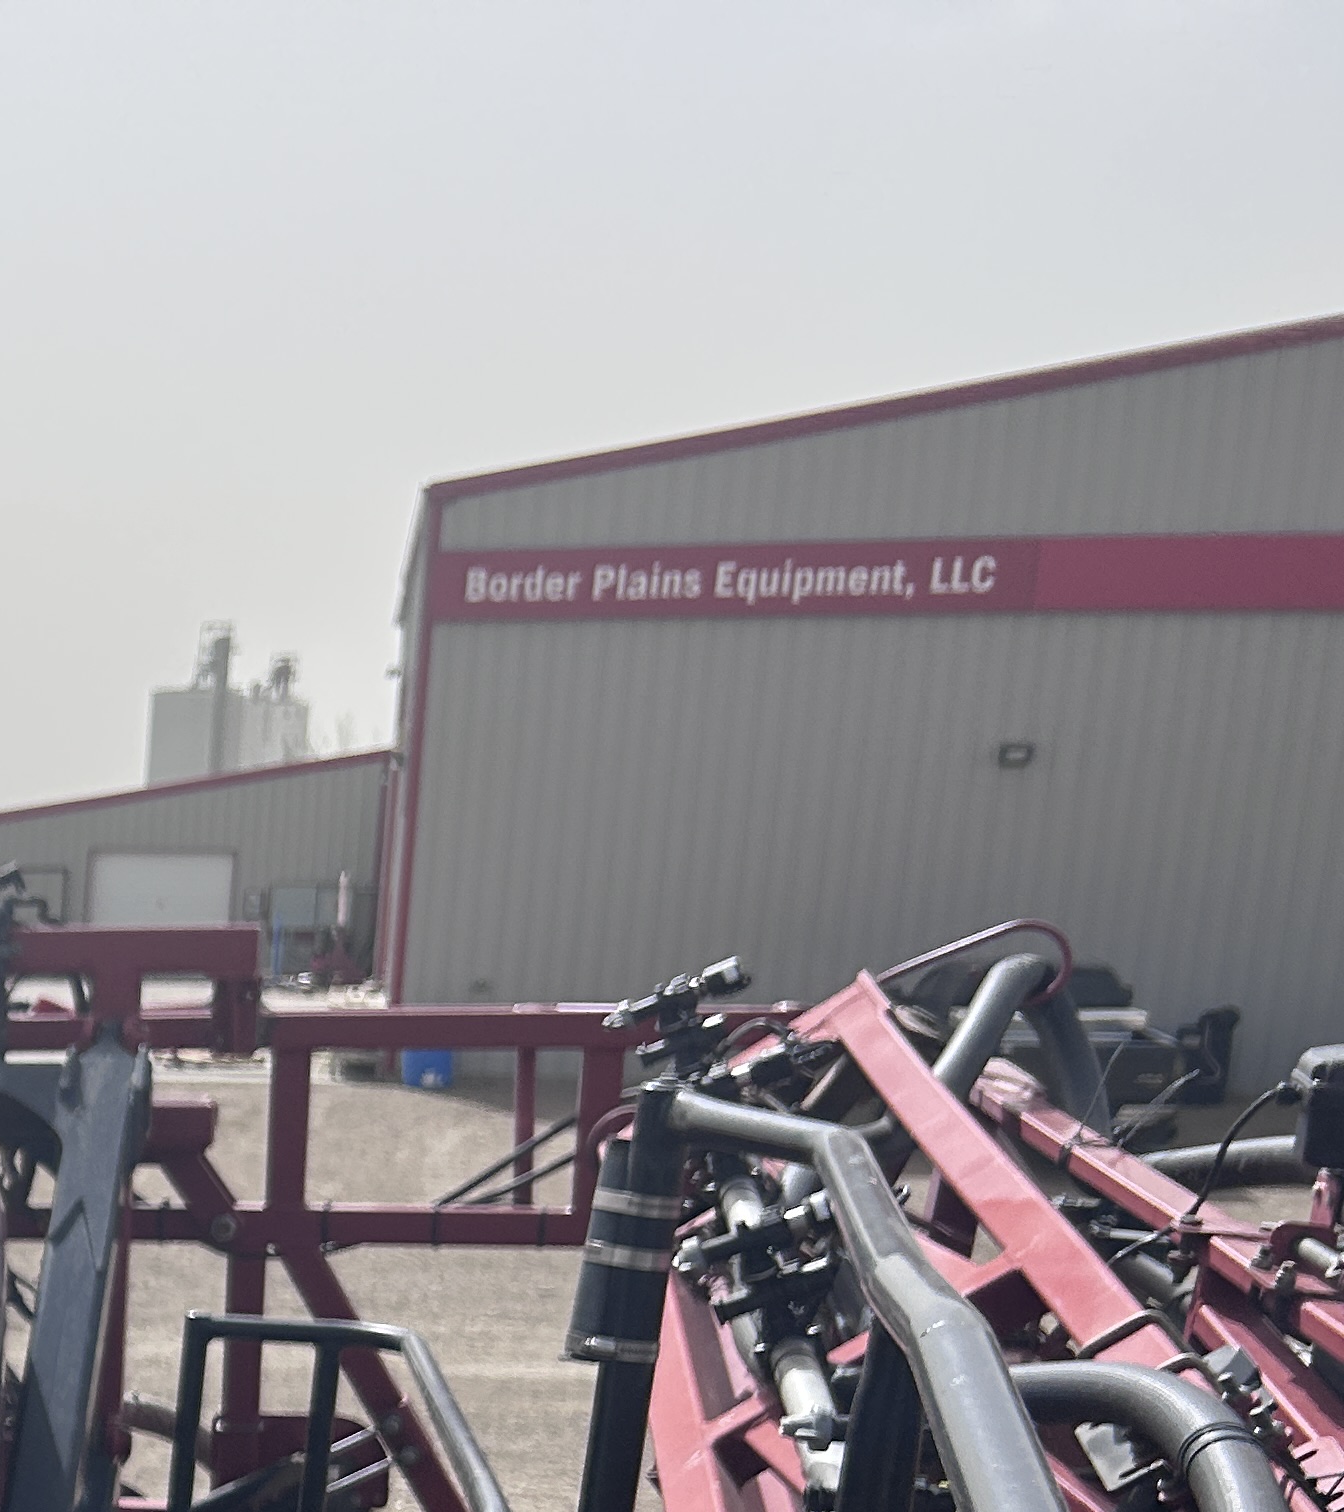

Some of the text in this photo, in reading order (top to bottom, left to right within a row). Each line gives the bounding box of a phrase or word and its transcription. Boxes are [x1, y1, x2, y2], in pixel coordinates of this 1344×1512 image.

[464, 555, 998, 606] Border Plains Equipment, LLC
